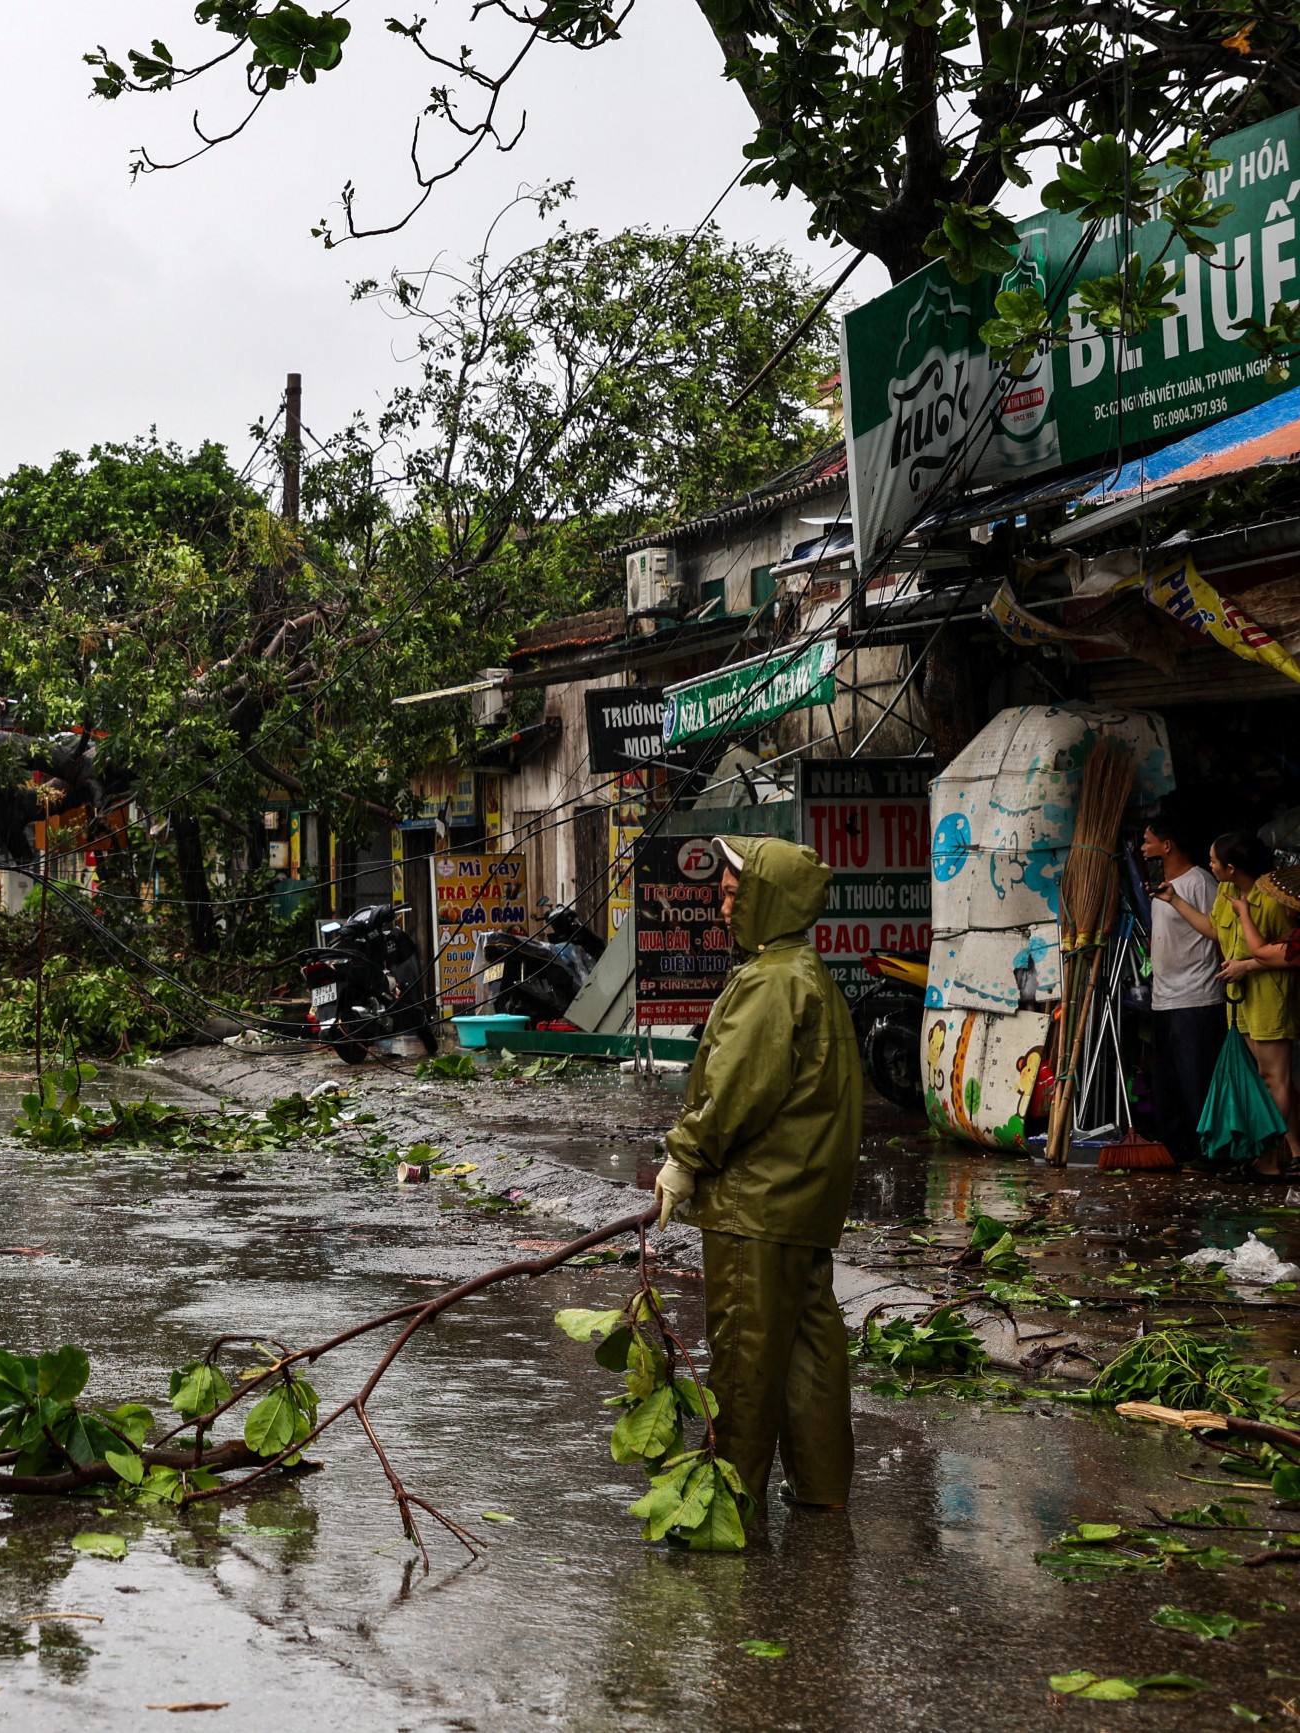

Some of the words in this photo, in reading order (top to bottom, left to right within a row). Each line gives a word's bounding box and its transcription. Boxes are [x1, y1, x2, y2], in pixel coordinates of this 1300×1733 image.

[1239, 138, 1290, 189] HÓA
[1094, 405, 1109, 421] ĐC:
[1156, 381, 1176, 404] VIẾT
[1177, 375, 1205, 398] XUÂN,
[1205, 372, 1218, 390] TP
[1218, 368, 1245, 386] VINH,
[1168, 397, 1228, 427] 0904.797.936
[602, 699, 667, 729] TRƯỜNG
[810, 767, 874, 794] NHÀ
[880, 804, 931, 867] TRA
[458, 859, 482, 877] Mì
[438, 882, 467, 900] TRÀ
[639, 882, 713, 904] Trường
[845, 876, 895, 910] THUỐC
[461, 902, 486, 924] GÀ
[491, 901, 525, 923] RÁN
[439, 927, 468, 946] Ăn
[638, 930, 664, 951] MUA
[665, 926, 690, 950] BÁN
[815, 924, 870, 954] BAO
[880, 923, 932, 953] CAO
[660, 953, 694, 975] ĐIỆN
[639, 977, 656, 991] ÉP
